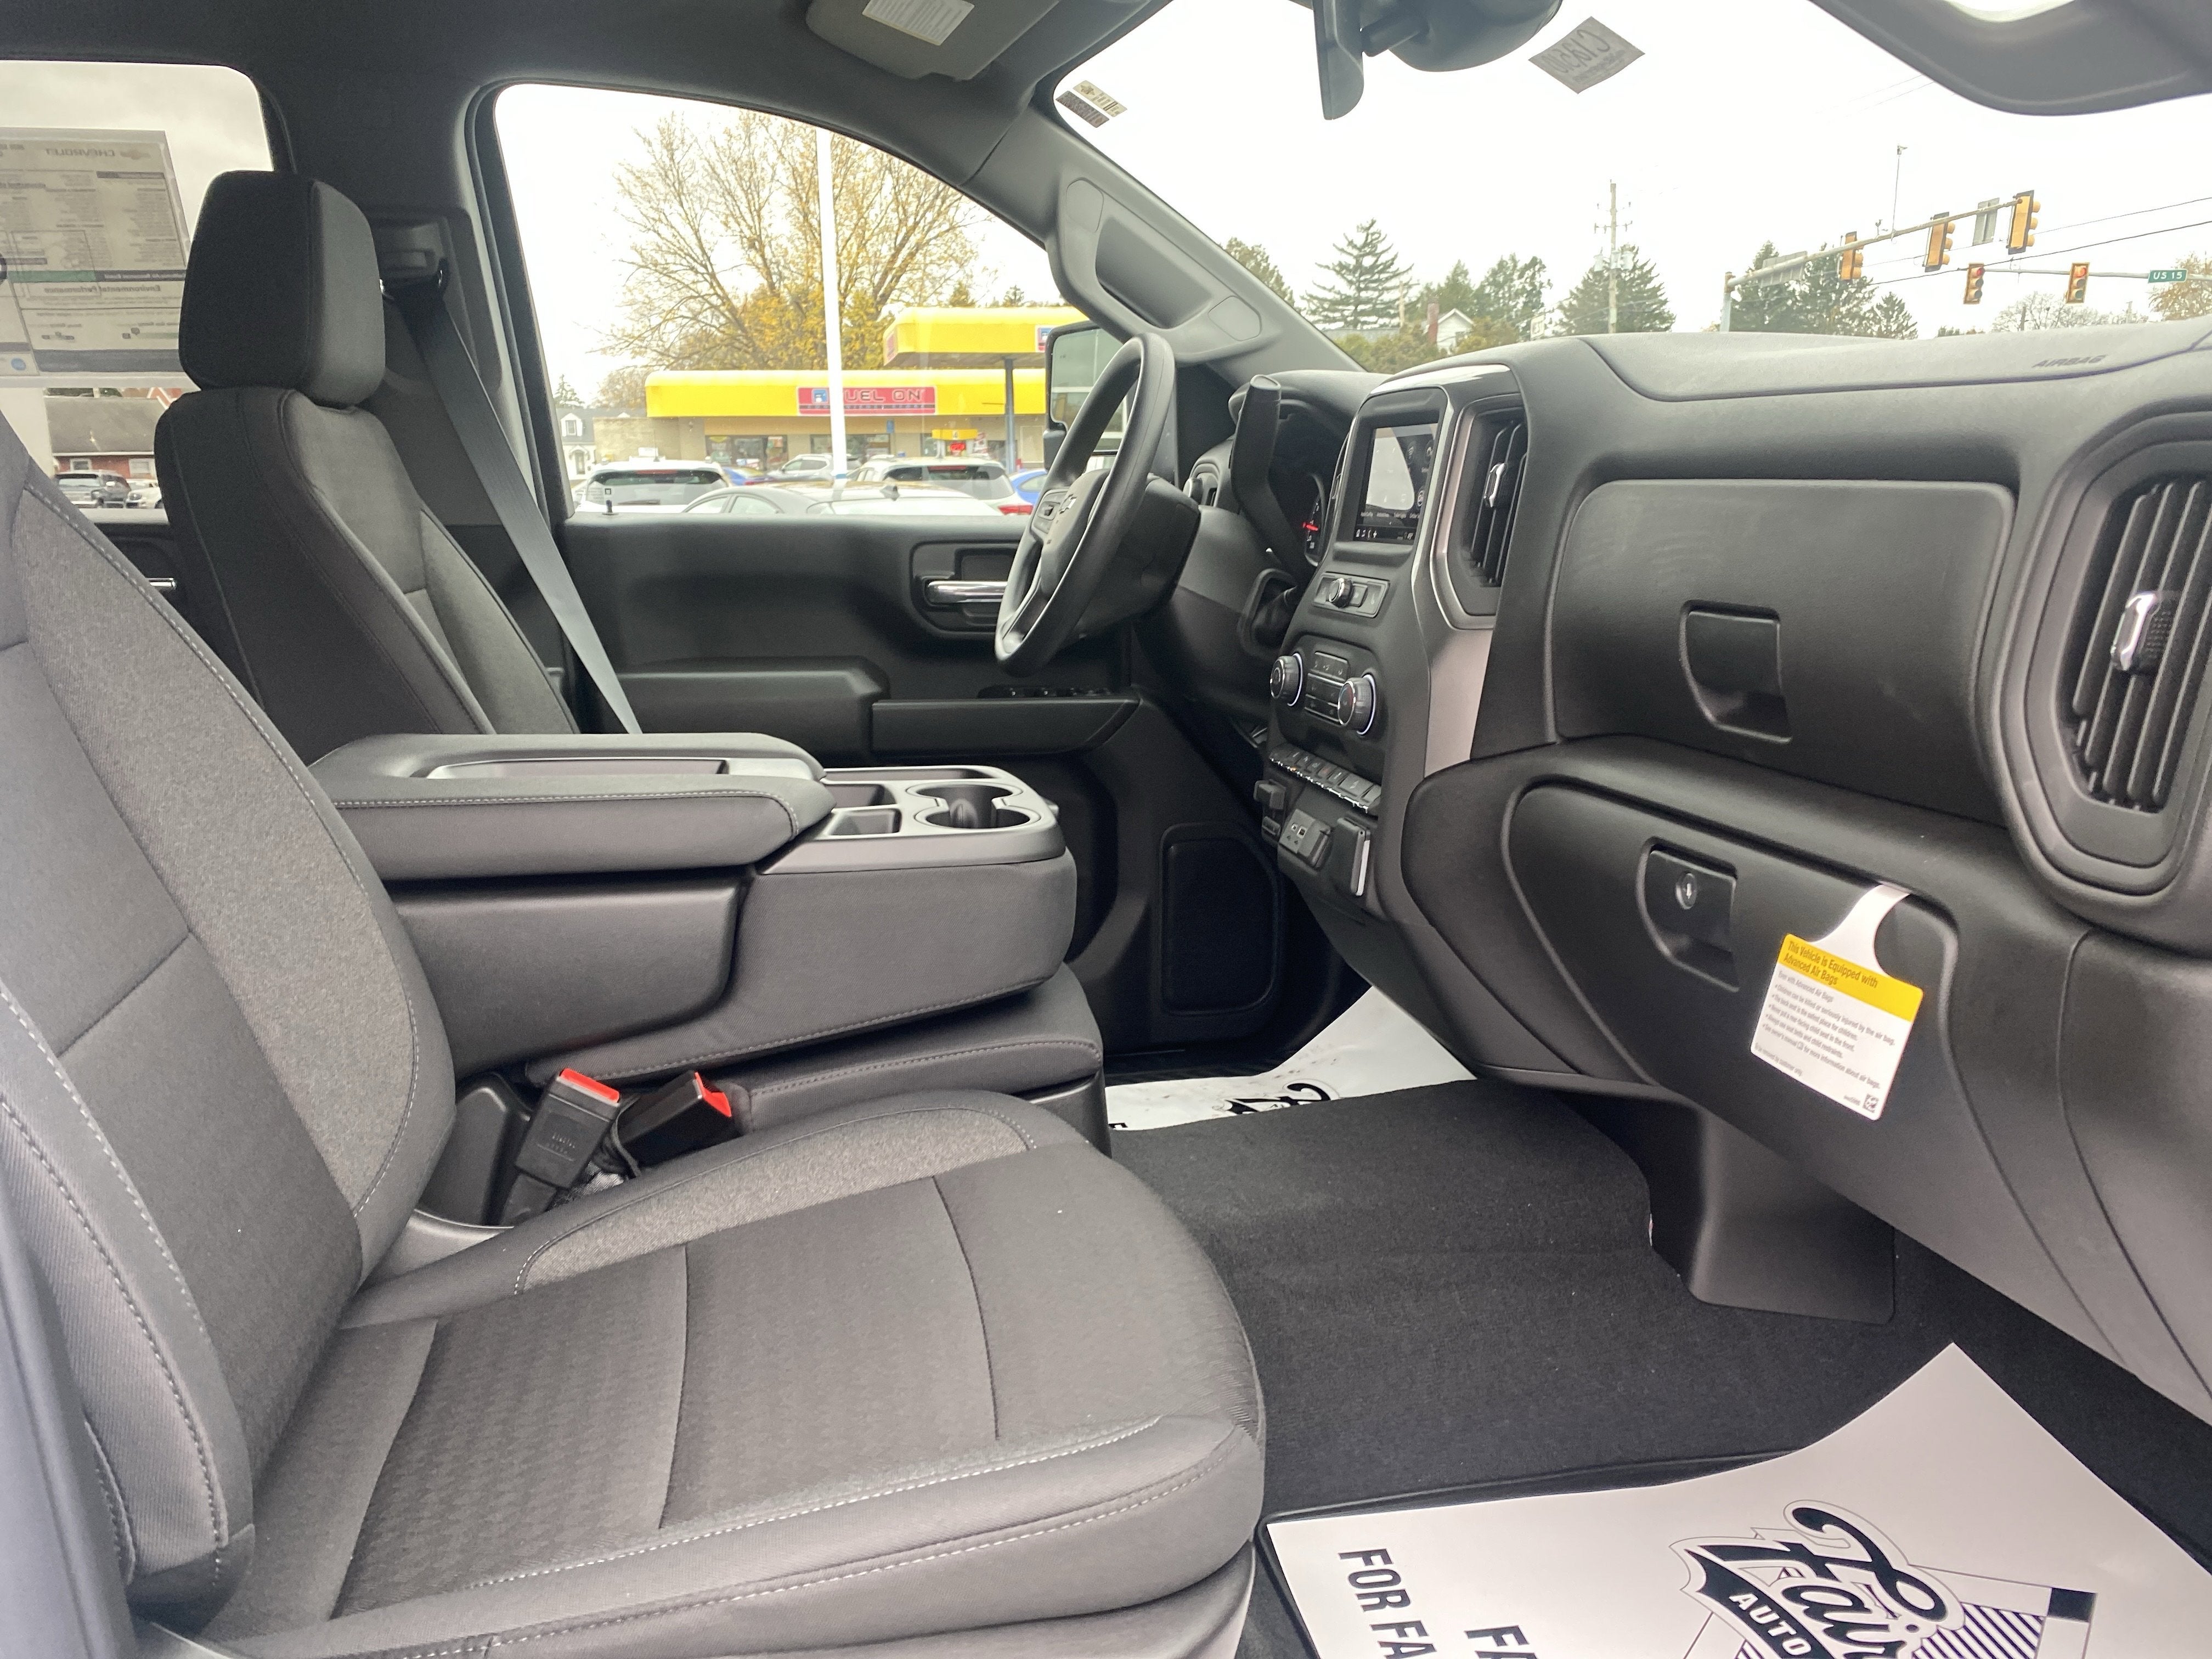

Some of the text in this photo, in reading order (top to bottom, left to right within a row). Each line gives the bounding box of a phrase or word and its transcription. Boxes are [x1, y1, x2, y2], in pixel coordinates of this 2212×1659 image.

[2153, 271, 2182, 280] US 15
[844, 389, 921, 401] UEL ON
[1784, 953, 1837, 985] Advanced Air Bags
[1788, 941, 1877, 987] This Vehicle is Equipped with
[1337, 1548, 1412, 1612] FOR
[1729, 1593, 1812, 1656] AUTO
